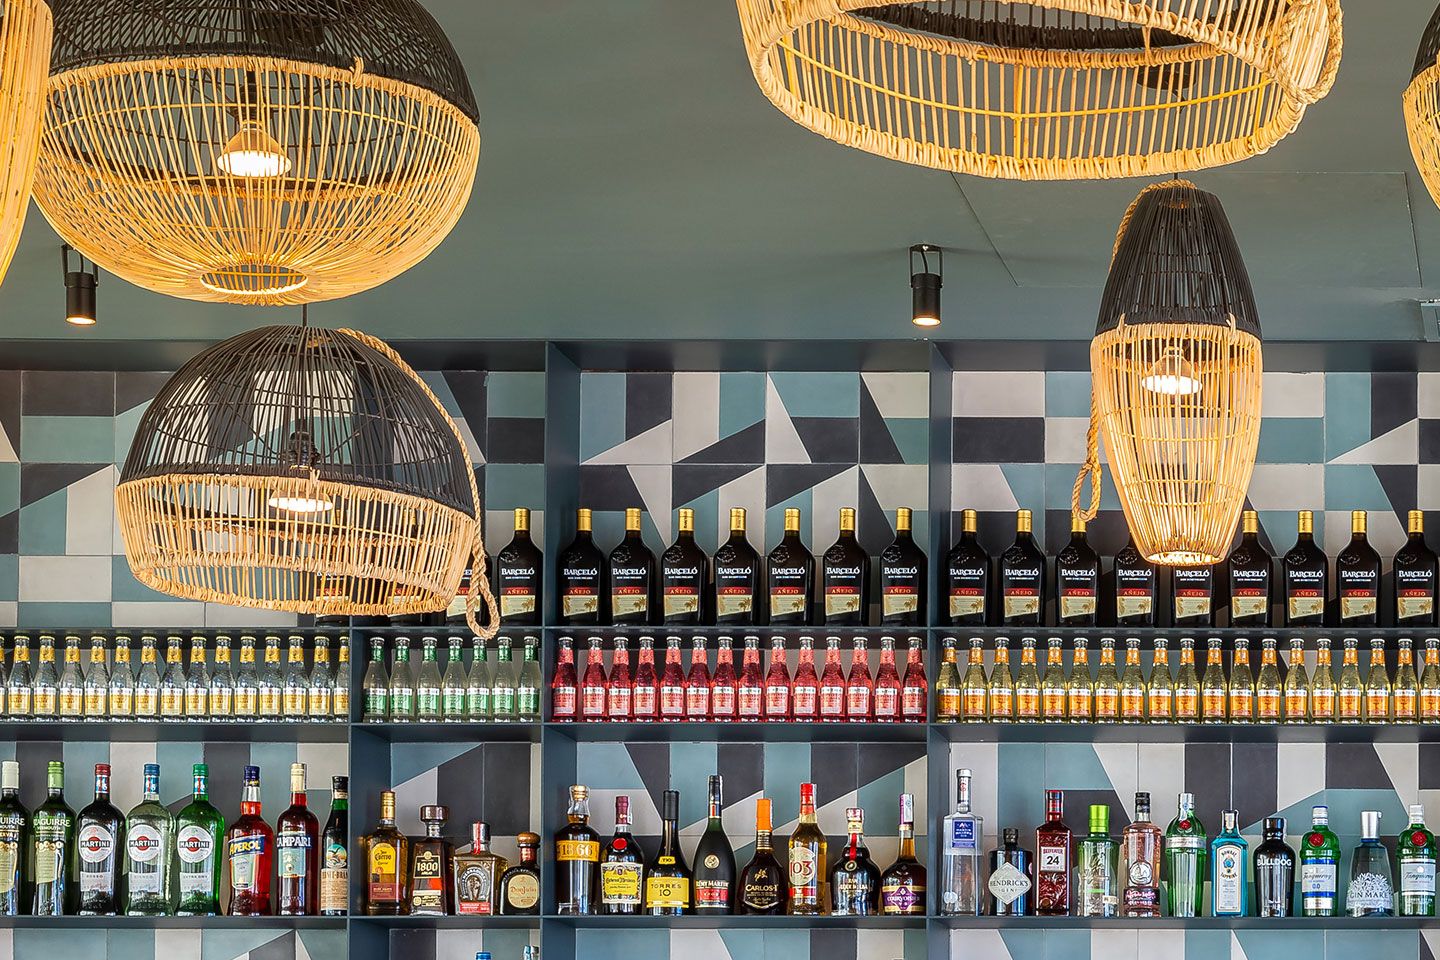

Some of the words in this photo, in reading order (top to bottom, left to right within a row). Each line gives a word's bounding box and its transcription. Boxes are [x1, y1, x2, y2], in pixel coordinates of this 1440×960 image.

[501, 567, 535, 576] BARCELÓ
[563, 567, 597, 576] BARCELÓ
[612, 567, 646, 576] BARCELÓ
[664, 566, 698, 575] BARCELÓ
[717, 566, 751, 575] BARCELÓ
[771, 566, 805, 575] BARCELÓ
[826, 566, 860, 575] BARCELÓ
[883, 566, 917, 575] BARCELÓ
[950, 567, 984, 576] BARCELÓ
[1005, 568, 1039, 577] BARCELÓ
[1061, 568, 1095, 577] BARCELÓ
[1118, 568, 1152, 577] BARCELÓ
[1176, 569, 1210, 578] BARCELÓ
[1233, 569, 1267, 578] BARCELÓ
[1289, 569, 1323, 578] BARCELÓ
[1342, 569, 1376, 578] BARCELÓ
[1398, 569, 1432, 578] BARCELÓ
[230, 840, 260, 853] APEROL
[562, 845, 593, 857] 1866
[1046, 856, 1060, 865] 24
[1257, 858, 1292, 866] BULLDOG
[417, 861, 438, 871] 1800
[789, 860, 813, 876] 103
[659, 889, 672, 897] 10
